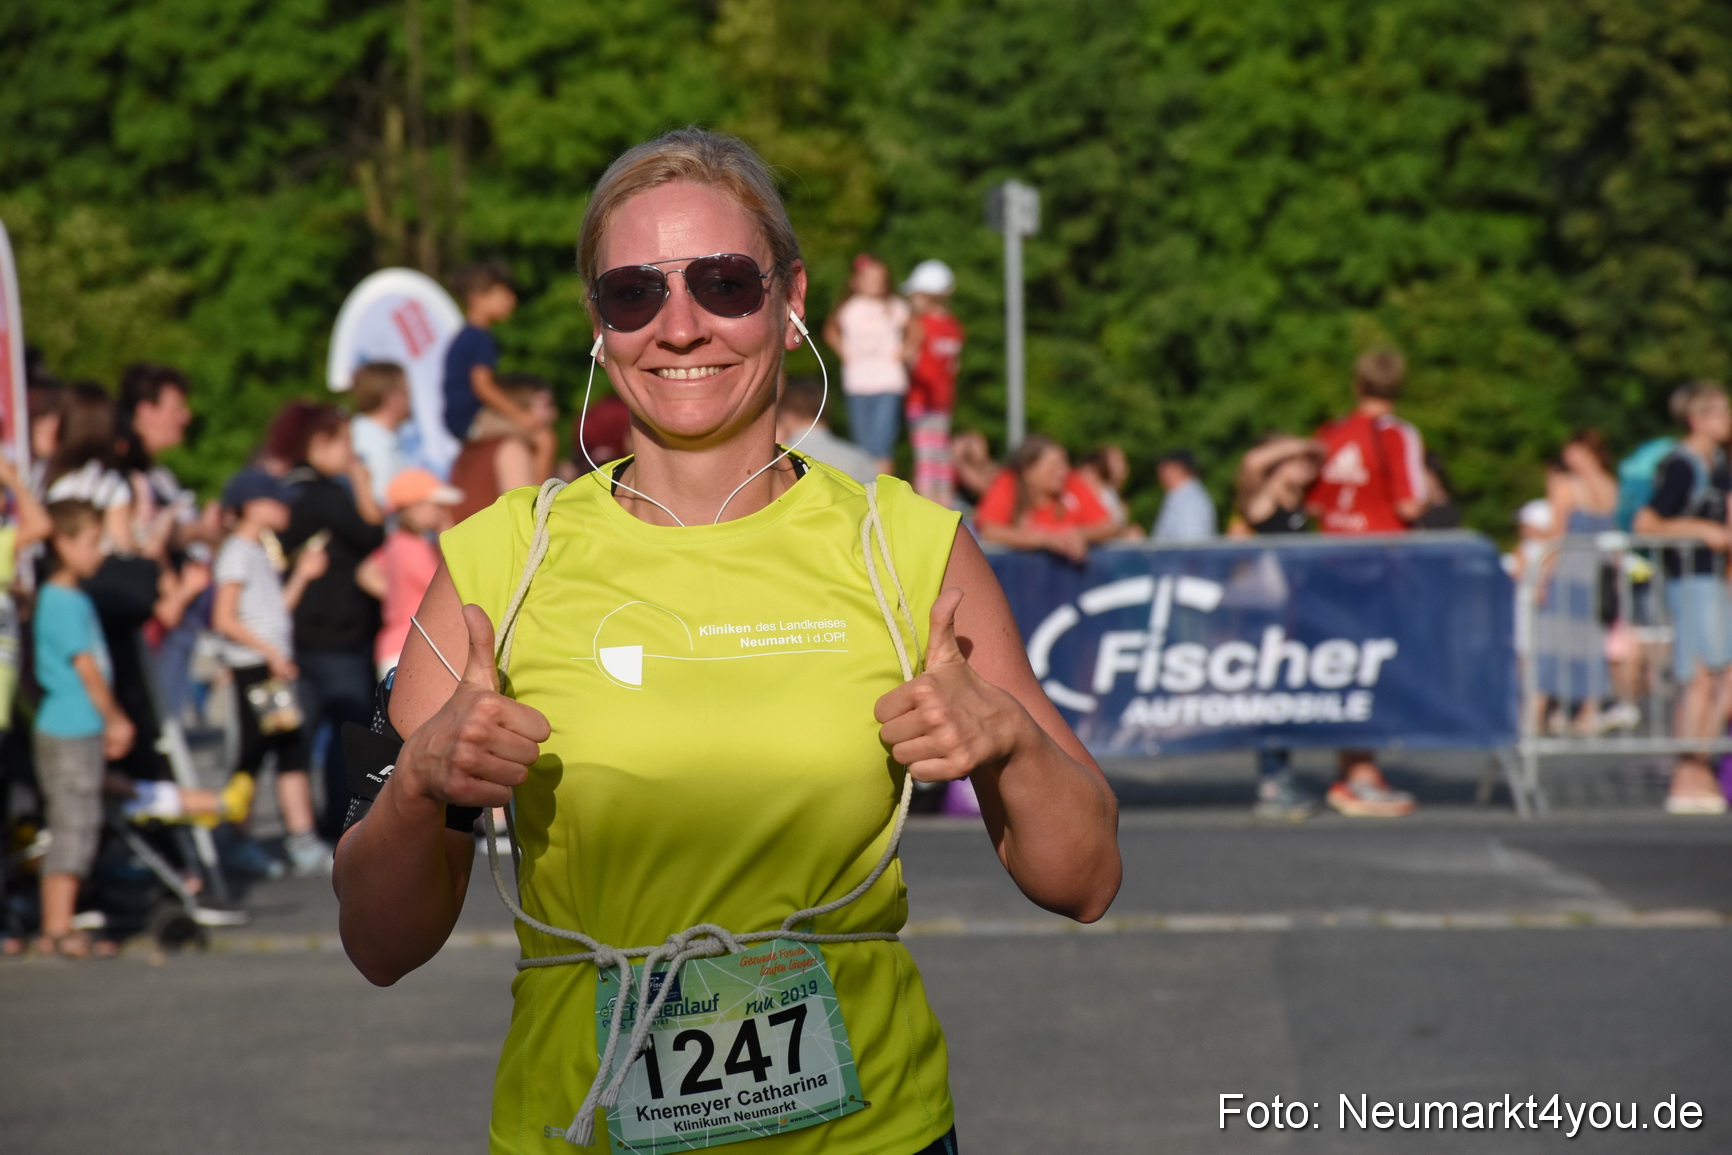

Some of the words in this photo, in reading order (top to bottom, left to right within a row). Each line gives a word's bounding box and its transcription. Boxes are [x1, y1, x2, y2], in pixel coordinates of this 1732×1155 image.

[699, 624, 751, 636] Kliniken
[756, 622, 776, 632] des
[780, 619, 846, 631] Landkreises
[740, 634, 803, 648] Neumarkt
[1092, 624, 1398, 694] Fischer
[1121, 690, 1376, 726] AUTOMOBILE
[366, 773, 382, 783] PRO
[740, 949, 777, 967] Gesunde
[760, 962, 786, 976] laufen
[629, 993, 720, 1020] fenlauf
[745, 996, 774, 1015] run
[780, 980, 818, 1006] 2019
[631, 1018, 669, 1028] narkt
[634, 1003, 808, 1100] 1247
[636, 1096, 731, 1122] Knemeyer
[737, 1073, 828, 1107] Catharina
[674, 1114, 731, 1132] Klinikum
[734, 1100, 797, 1122] Neumarkt
